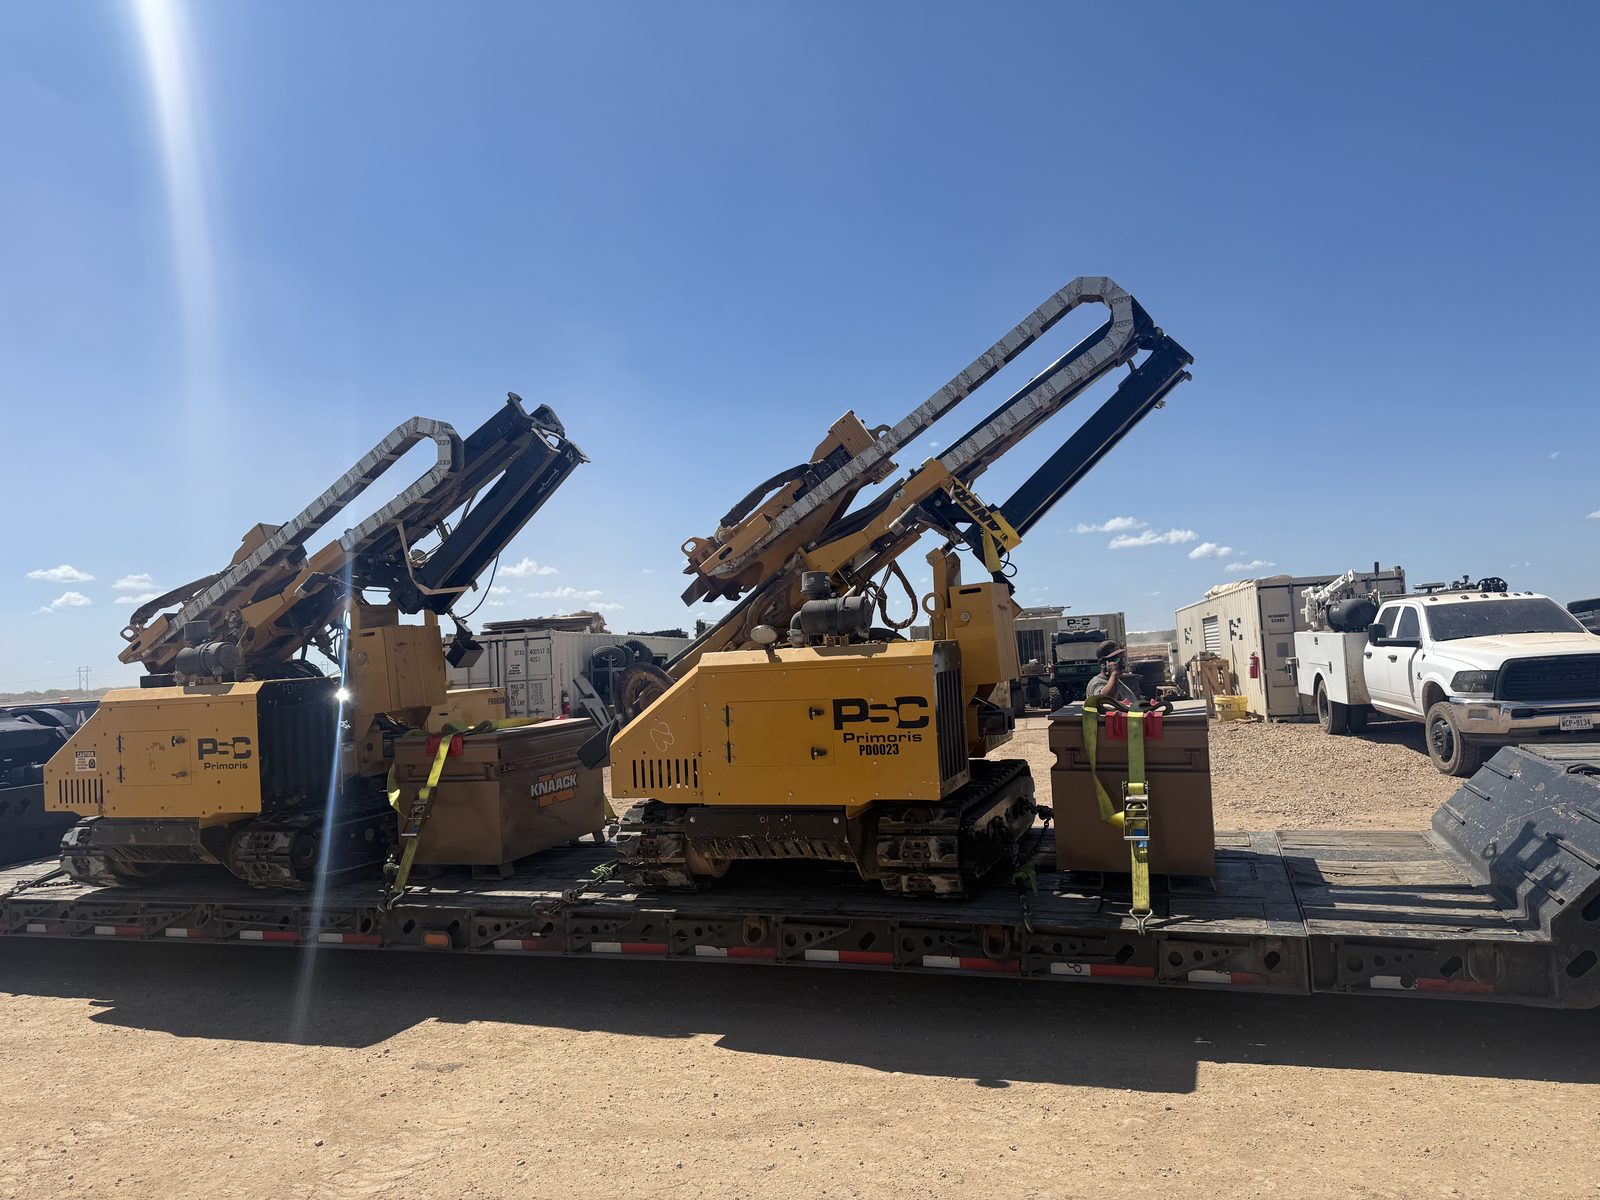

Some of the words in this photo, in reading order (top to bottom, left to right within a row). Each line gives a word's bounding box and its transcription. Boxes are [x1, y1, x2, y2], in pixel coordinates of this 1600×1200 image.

[843, 732, 922, 743] Primoris
[859, 743, 899, 756] PD0023
[204, 761, 248, 770] Primoris
[530, 773, 577, 798] KNAACK
